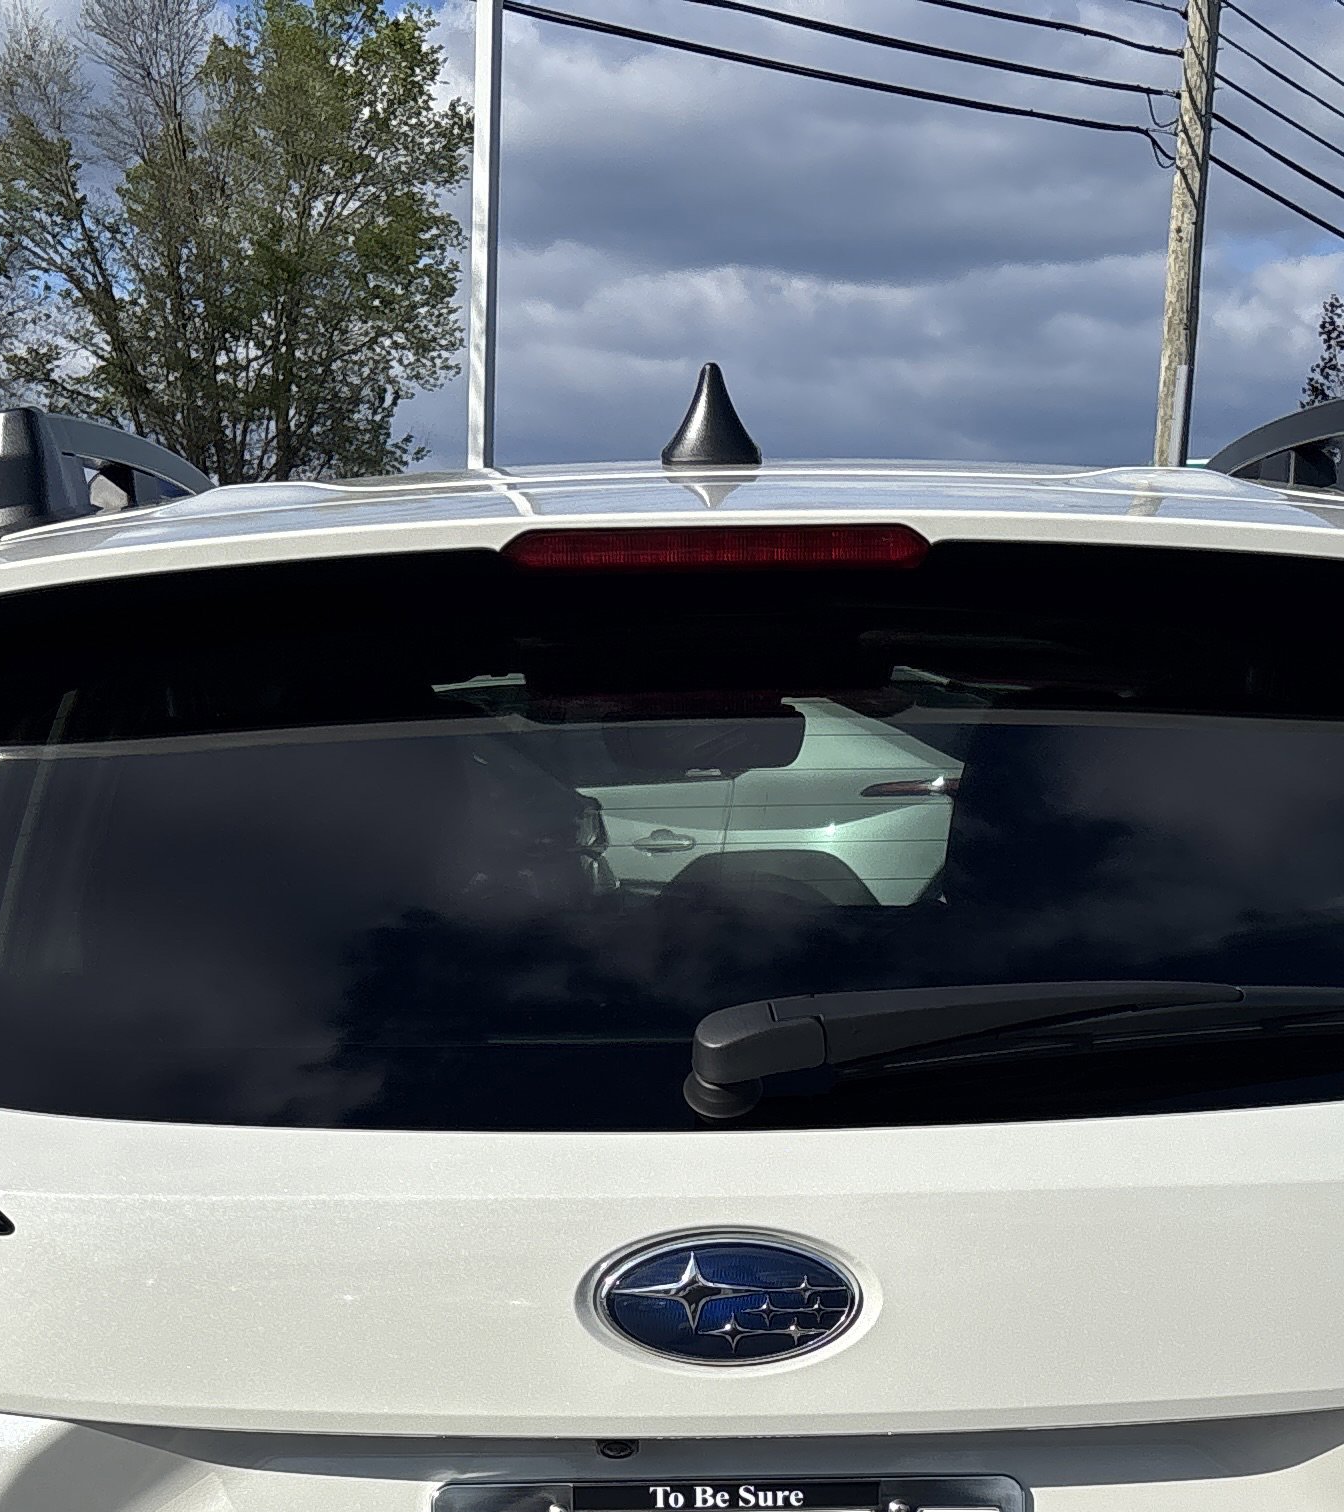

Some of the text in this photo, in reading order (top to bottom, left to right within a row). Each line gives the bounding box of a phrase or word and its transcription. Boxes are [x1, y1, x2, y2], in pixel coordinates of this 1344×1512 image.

[649, 1484, 805, 1508] To Be Sure
